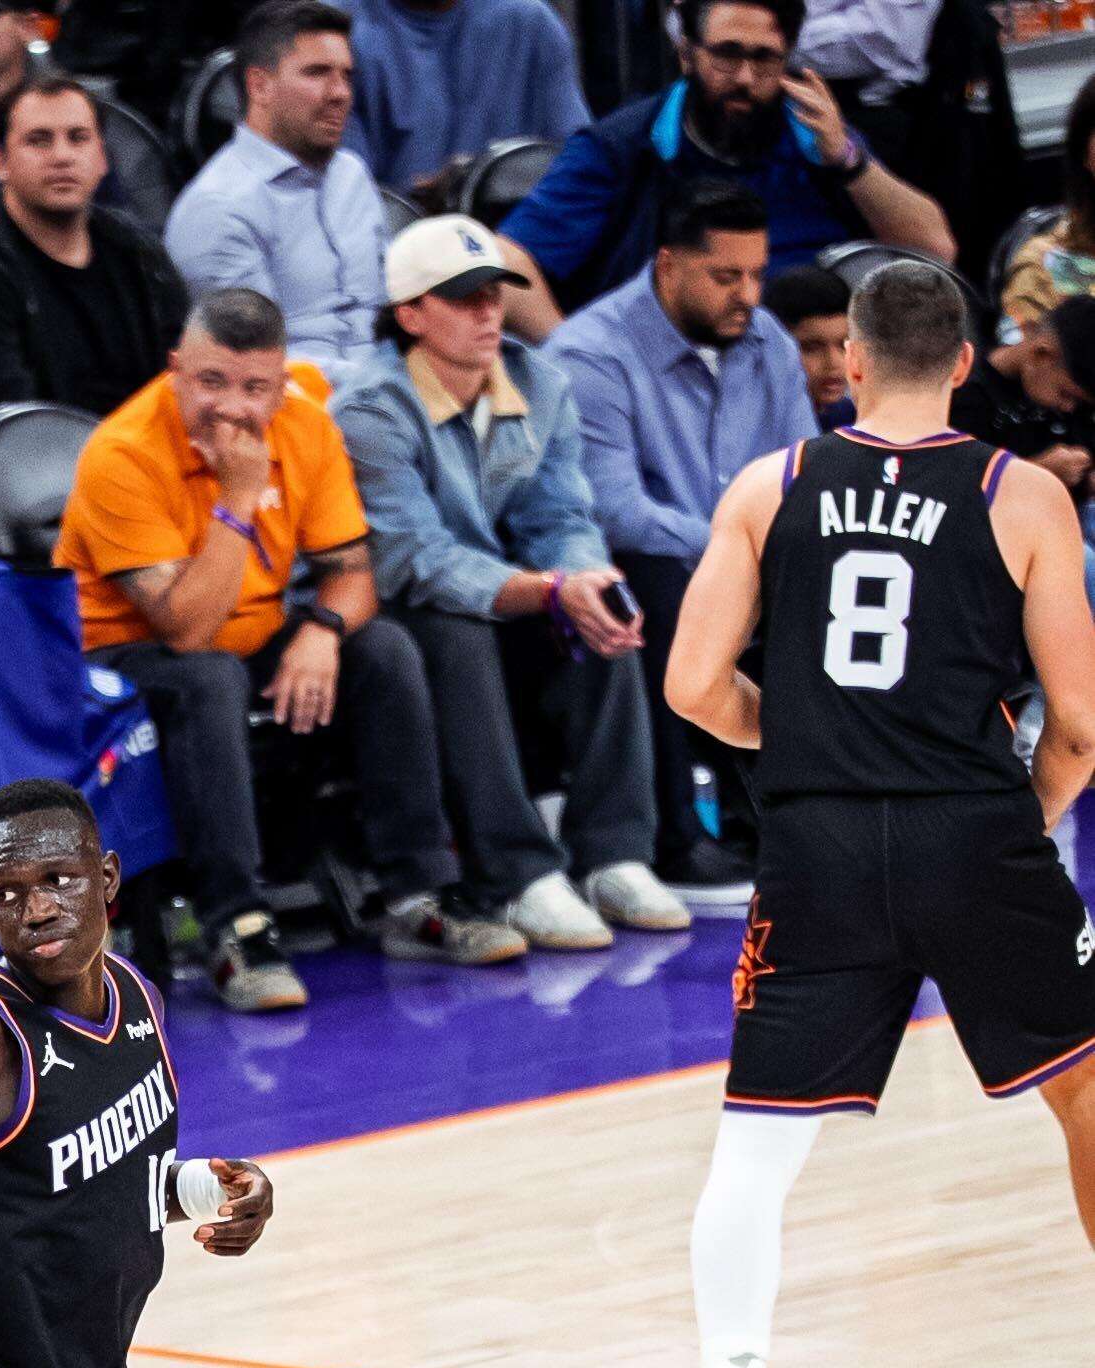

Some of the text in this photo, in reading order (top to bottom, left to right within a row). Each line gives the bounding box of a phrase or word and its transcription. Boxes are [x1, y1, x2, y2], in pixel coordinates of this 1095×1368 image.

[820, 487, 948, 546] ALLEN
[823, 550, 914, 691] 8
[47, 1060, 175, 1193] PHOENIX
